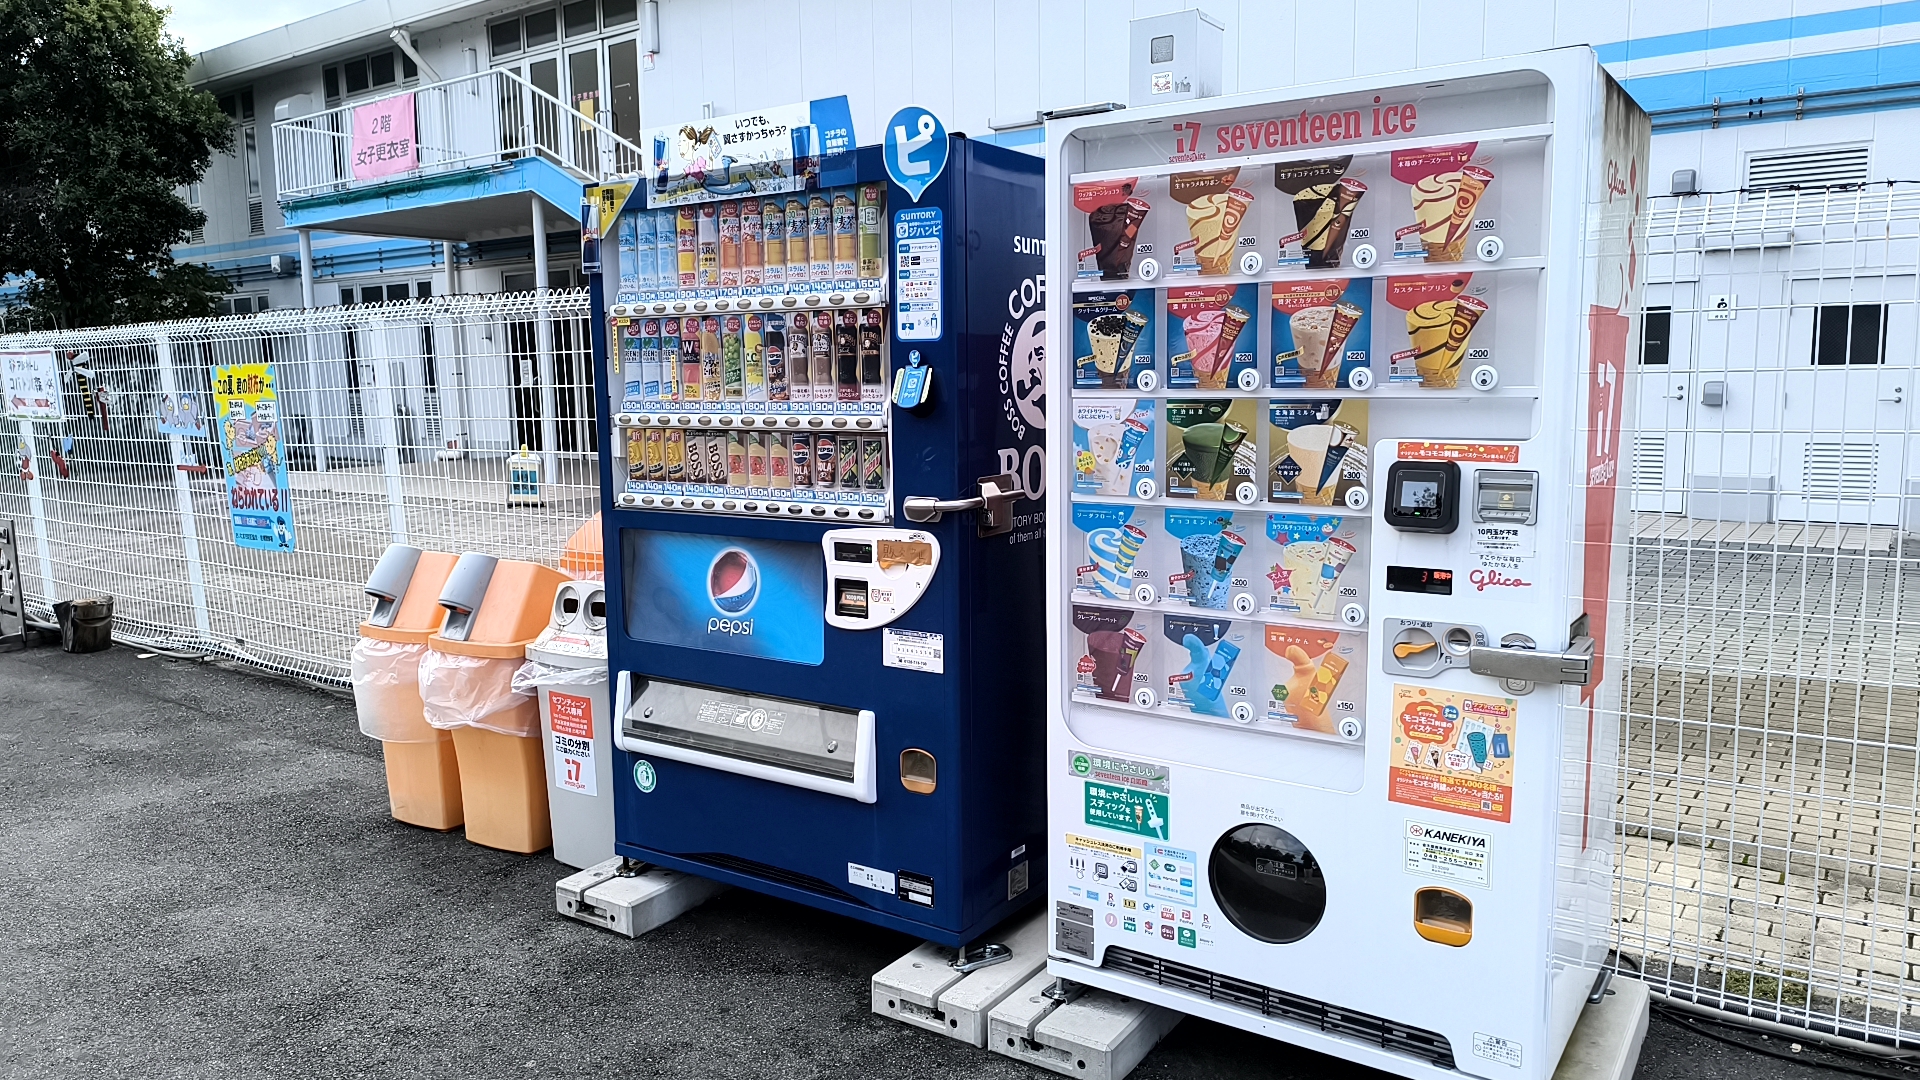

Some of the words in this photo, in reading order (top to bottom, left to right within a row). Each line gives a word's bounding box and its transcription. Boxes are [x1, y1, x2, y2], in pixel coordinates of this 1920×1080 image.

[734, 115, 770, 129] いつでも、
[1216, 108, 1362, 155] seventeen
[1371, 95, 1417, 137] ice
[824, 128, 847, 139] コチラの
[894, 114, 936, 176] ピ
[355, 138, 410, 166] 女子更衣室
[1397, 156, 1455, 168] 木苺のチーズケーキ
[1280, 169, 1331, 180] 生チョコティラミス
[1175, 179, 1221, 190] 生キャラメルリボン
[900, 211, 937, 221] SUNTORY
[766, 221, 783, 236] 麦茶
[789, 219, 808, 234] 麦茶
[813, 216, 832, 232] 麦茶
[837, 215, 856, 231] 麦茶
[909, 225, 941, 237] ジハンピ
[1393, 284, 1448, 294] カスタードプリン
[1172, 302, 1215, 310] 濃厚いちご
[1277, 297, 1325, 306] 贅沢マカダミア
[627, 324, 639, 333] 600
[645, 324, 657, 333] 600
[665, 322, 678, 332] 600
[682, 341, 694, 354] W
[998, 322, 1015, 395] COFFEE
[622, 402, 640, 410] 160円
[661, 402, 680, 410] 160円
[702, 402, 721, 410] 180円
[745, 402, 764, 411] 180円
[790, 402, 809, 411] 190円
[837, 402, 860, 411] 190円
[1003, 398, 1026, 441] BOSS
[687, 442, 704, 481] BOSS
[707, 443, 725, 479] BOSS
[628, 482, 645, 490] 140円
[664, 483, 682, 492] 140円
[706, 485, 724, 494] 140円
[748, 488, 767, 496] 160円
[793, 490, 813, 498] 150円
[838, 492, 860, 501] 150円
[1077, 512, 1117, 520] ソーダフロート
[1170, 518, 1213, 526] チョコミント
[1017, 530, 1034, 543] them
[1477, 528, 1519, 537] 10円玉が不足
[1270, 571, 1289, 580] 大人気
[1469, 569, 1532, 592] Glico
[1077, 614, 1117, 624] グレープシャーベット
[707, 617, 754, 637] pepsi
[552, 695, 587, 709] セブンティーン
[555, 704, 583, 717] アイス専用
[1409, 725, 1445, 735] パスケース
[555, 735, 590, 752] ゴミの分別
[1092, 757, 1155, 777] 環境にやさしい
[1094, 771, 1121, 782] seventeen
[1121, 774, 1130, 783] ice
[1089, 786, 1143, 804] 環境にやさしい
[1089, 798, 1131, 815] スティックを
[1089, 808, 1133, 823] 使用しています。
[1423, 828, 1486, 848] KANEKIYA
